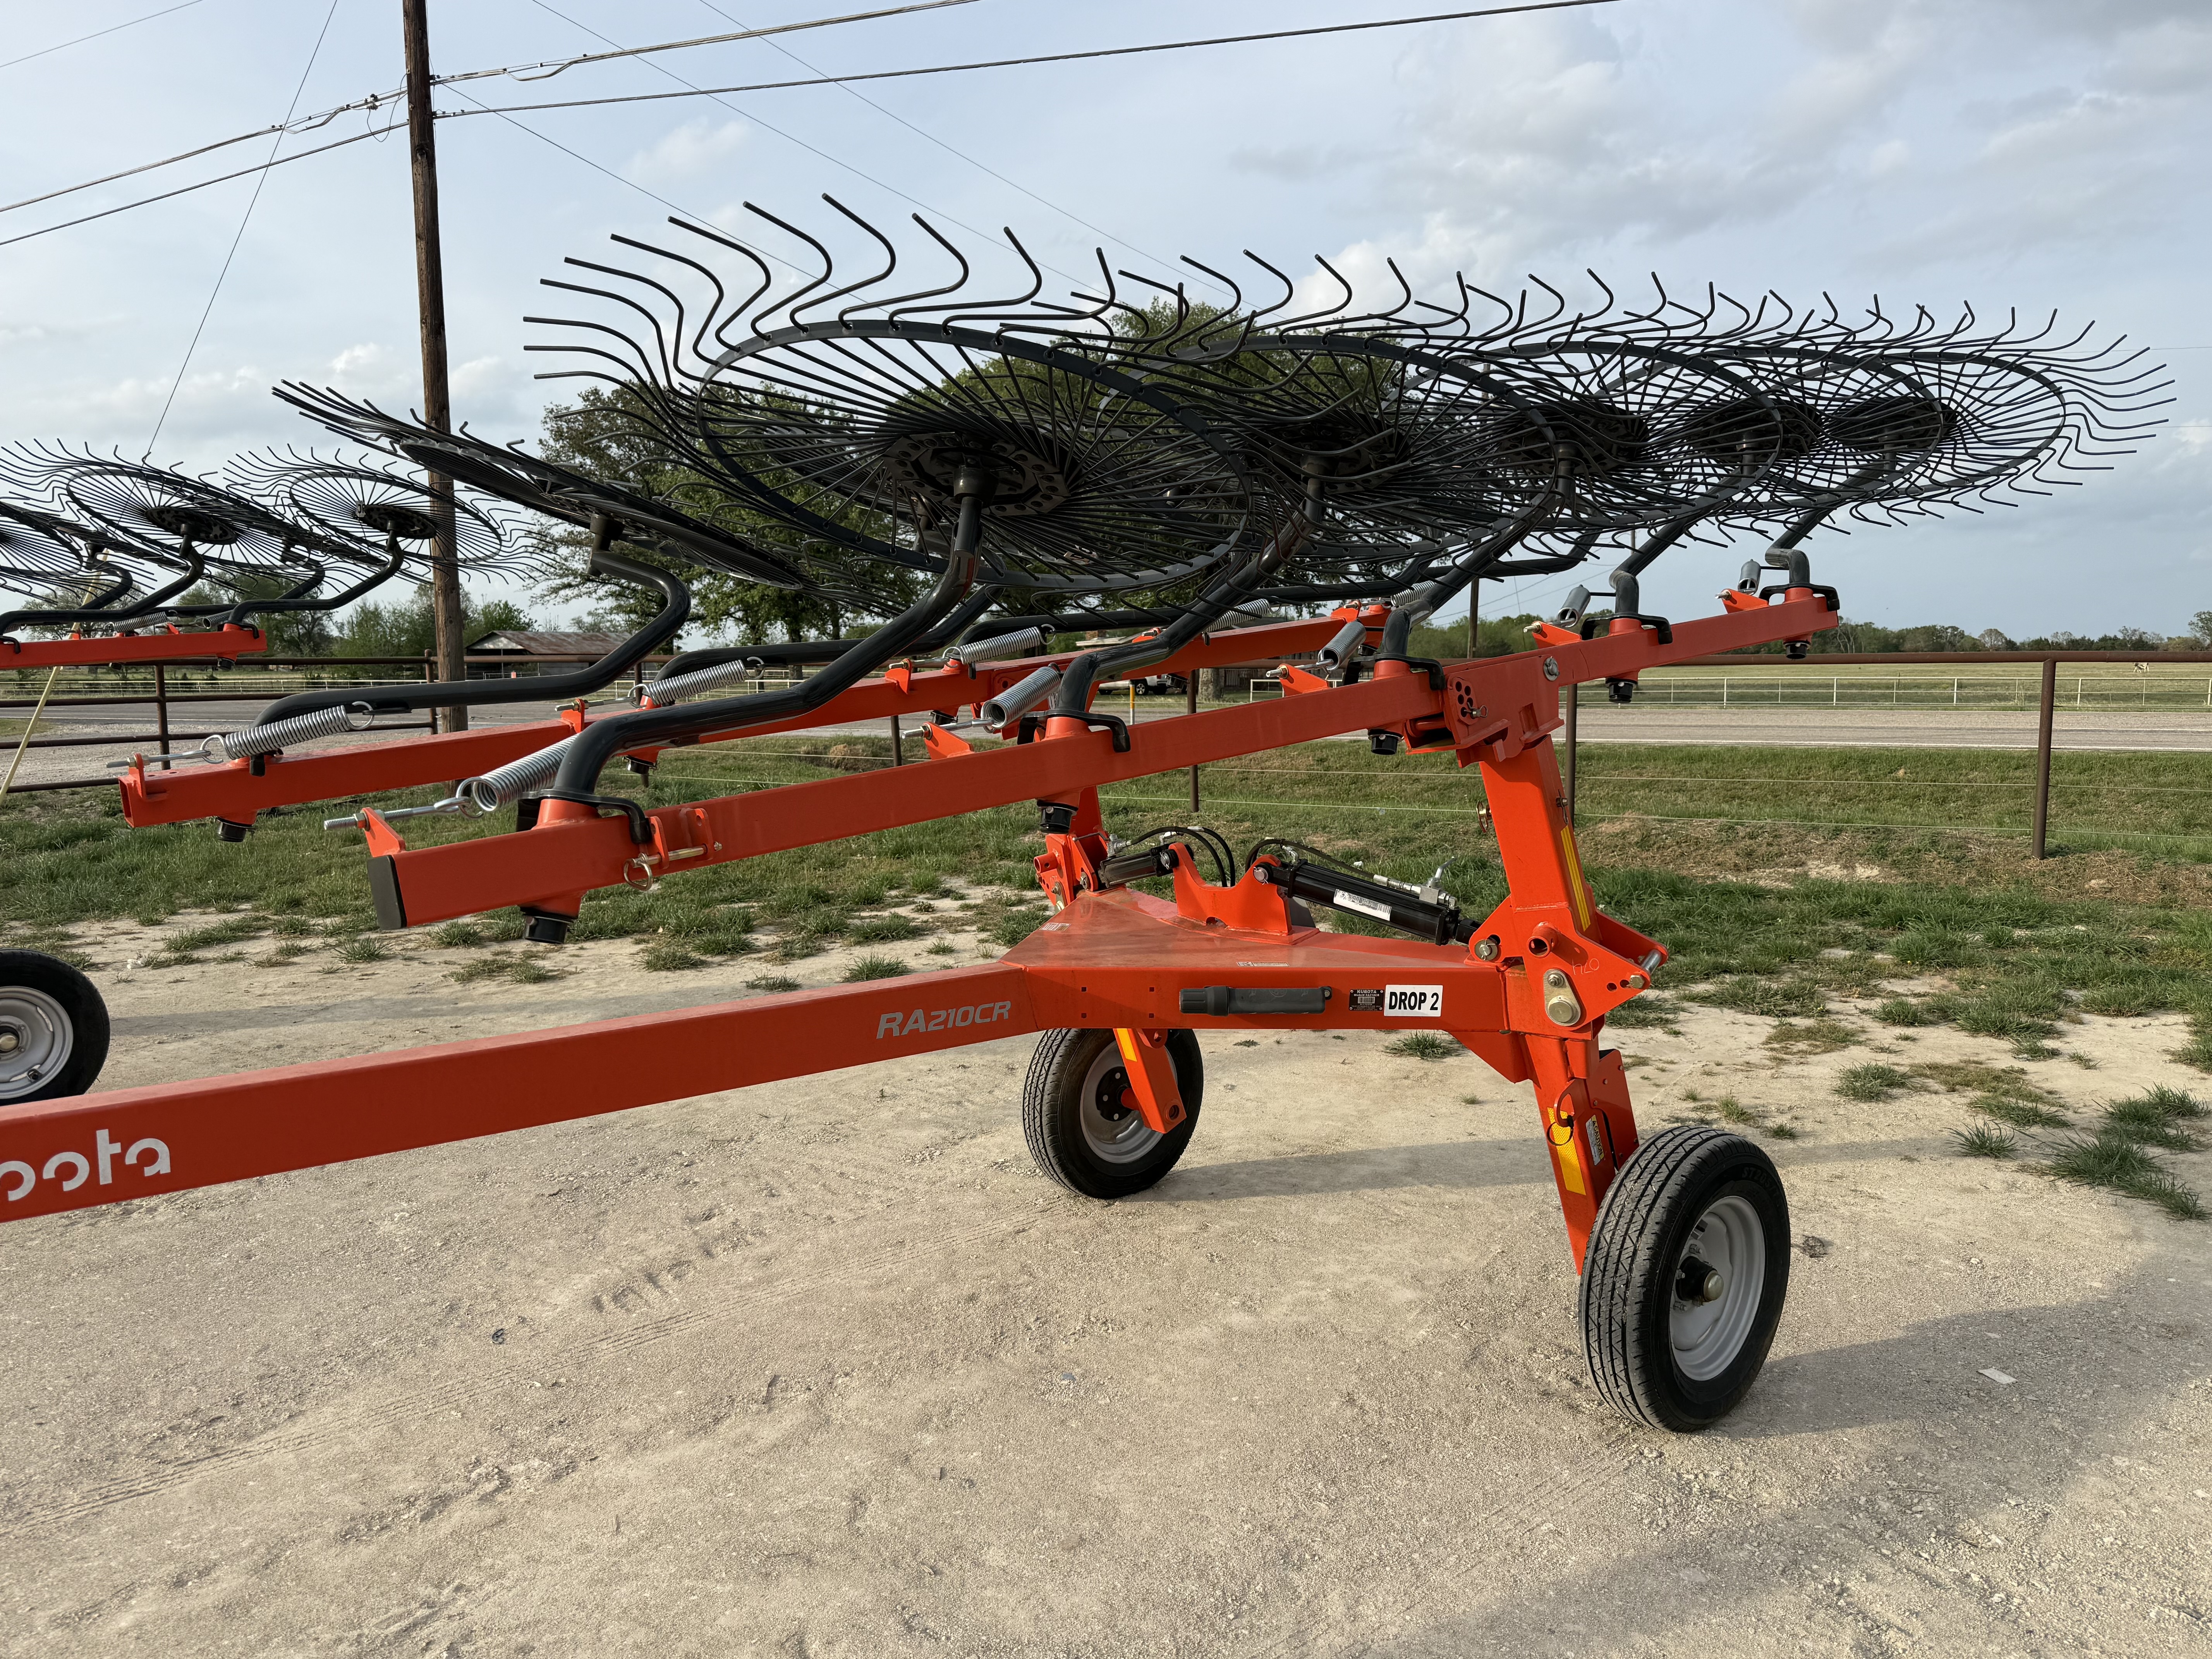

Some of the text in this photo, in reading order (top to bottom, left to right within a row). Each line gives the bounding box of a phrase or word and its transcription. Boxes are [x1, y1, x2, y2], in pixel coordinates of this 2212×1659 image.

[1389, 991, 1439, 1011] DROP 2
[876, 1001, 1012, 1039] RA210CR
[1594, 1125, 1603, 1156] CAUTION
